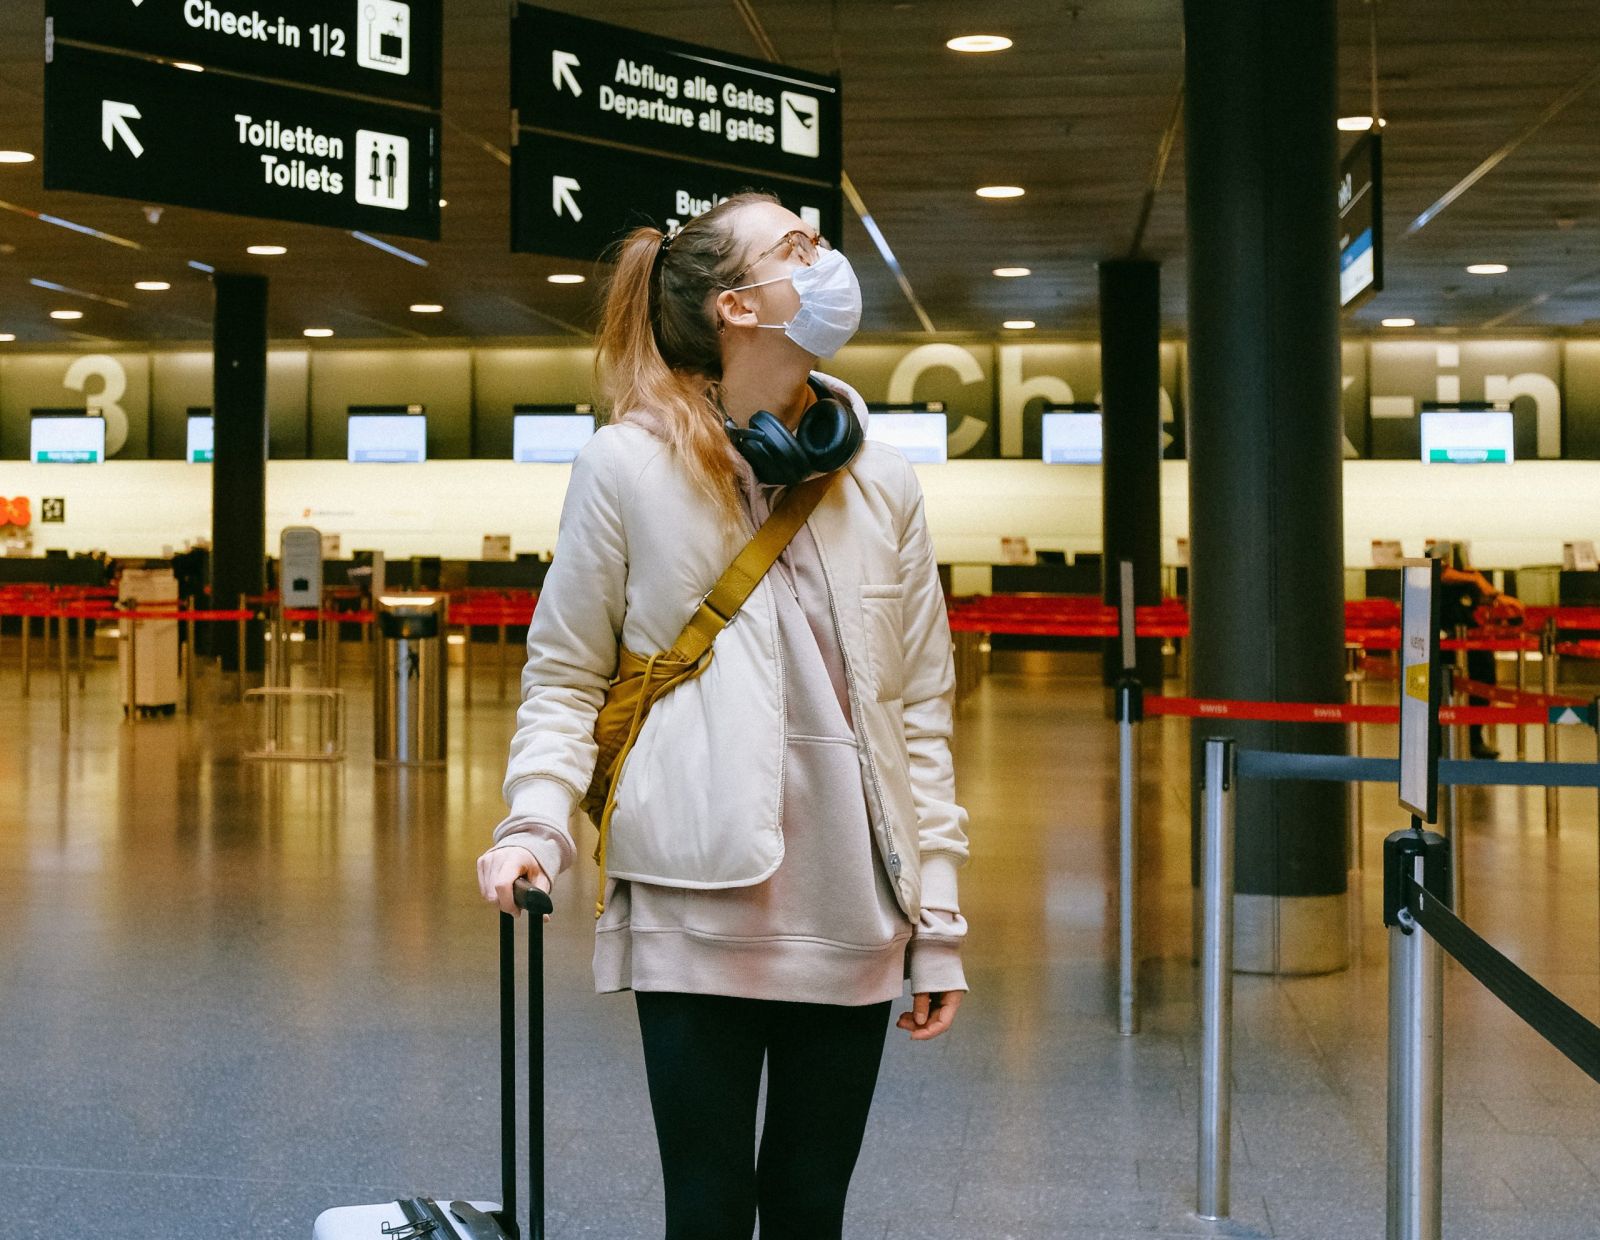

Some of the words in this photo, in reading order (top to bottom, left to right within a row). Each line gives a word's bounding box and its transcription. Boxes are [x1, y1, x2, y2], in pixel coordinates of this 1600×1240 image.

[184, 0, 300, 48] Check-in
[615, 59, 678, 99] Abflug
[683, 76, 718, 104] alle
[722, 83, 775, 116] Gates
[235, 114, 343, 160] Toiletten
[600, 86, 694, 127] Departure
[699, 109, 721, 133] all
[726, 117, 775, 145] gates
[261, 154, 343, 195] Toilets
[63, 354, 128, 456] 3
[1199, 704, 1228, 714] SWISS
[1313, 708, 1342, 718] SWISS
